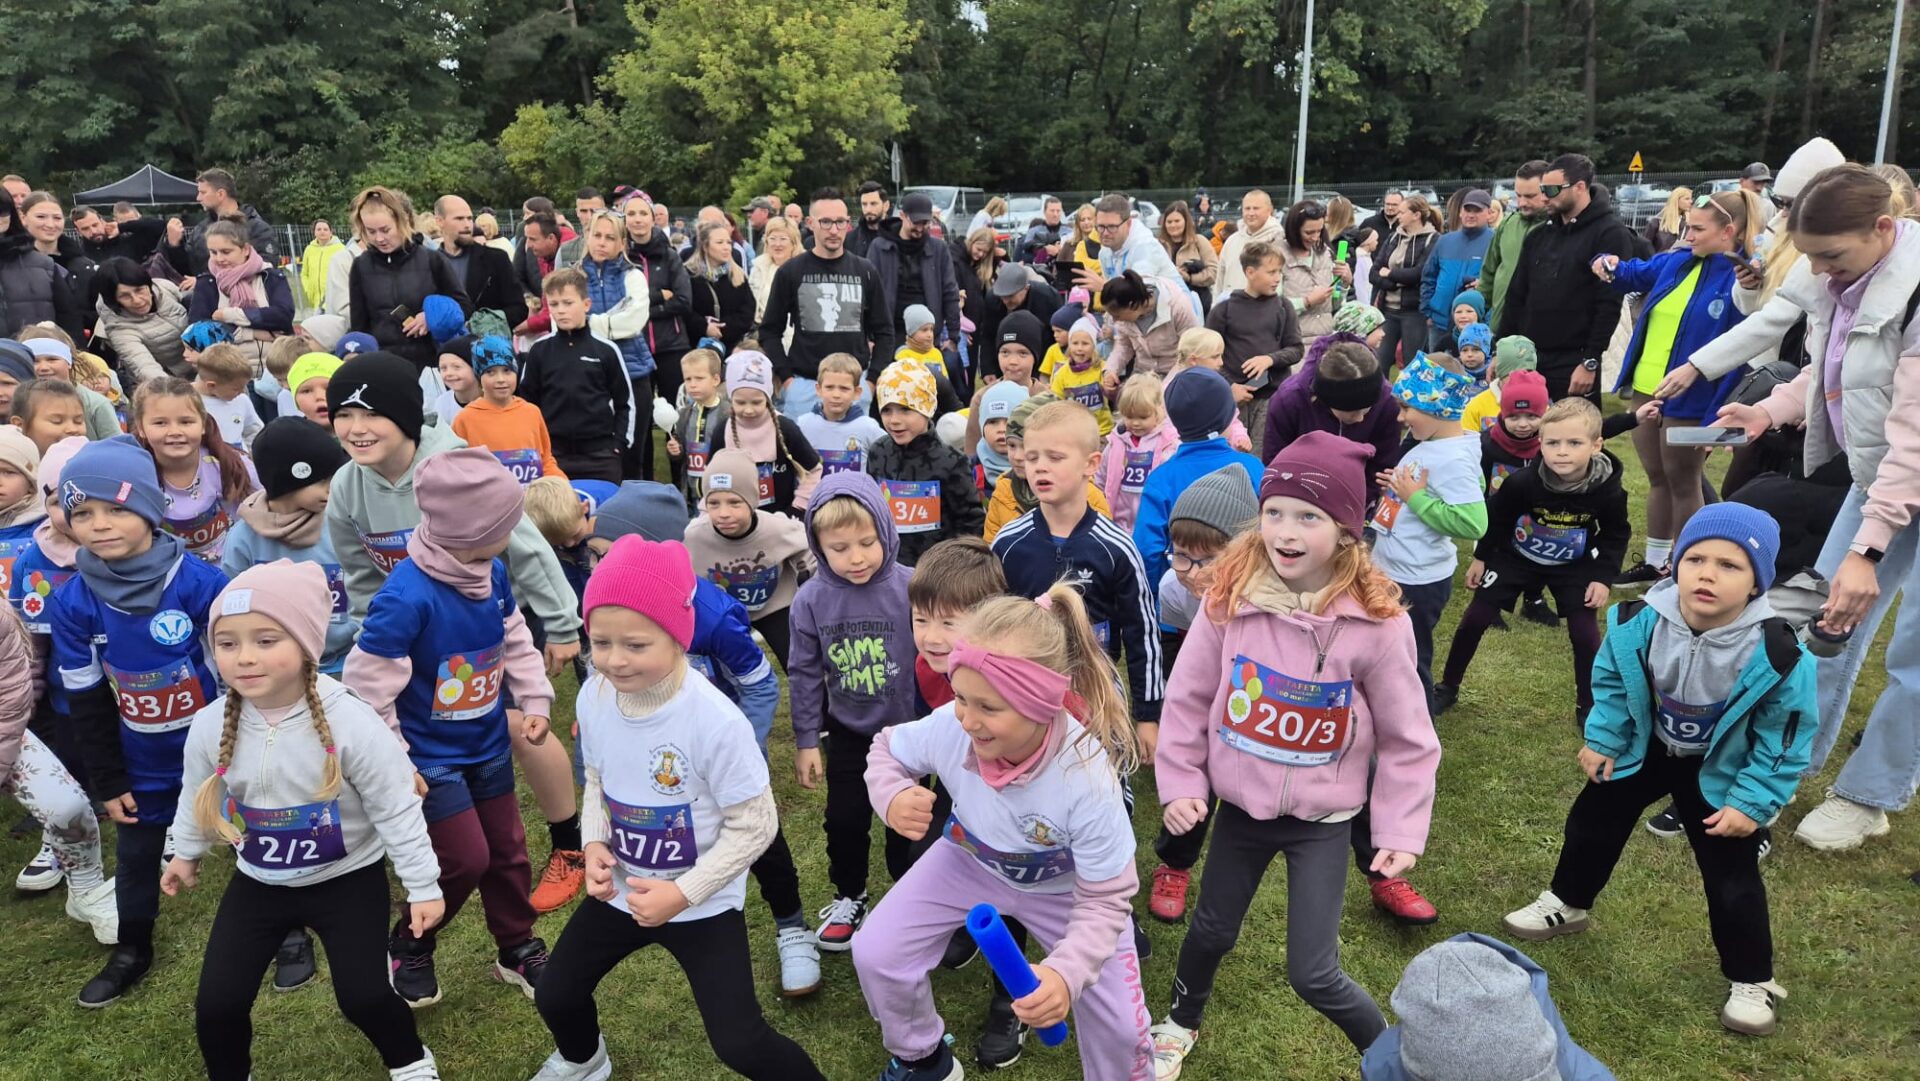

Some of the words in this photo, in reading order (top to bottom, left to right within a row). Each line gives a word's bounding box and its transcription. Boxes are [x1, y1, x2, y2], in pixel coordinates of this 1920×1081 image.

[1126, 467, 1145, 483] 23
[895, 501, 928, 521] 3/4
[1529, 538, 1576, 560] 22/1
[738, 588, 768, 603] 3/1
[819, 623, 846, 636] YOUR
[846, 620, 896, 633] POTENTIAL
[828, 636, 887, 669] GAME
[121, 690, 195, 718] 33/3
[1254, 702, 1337, 747] 20/3
[258, 836, 320, 865] 2/2
[615, 827, 684, 865] 17/2
